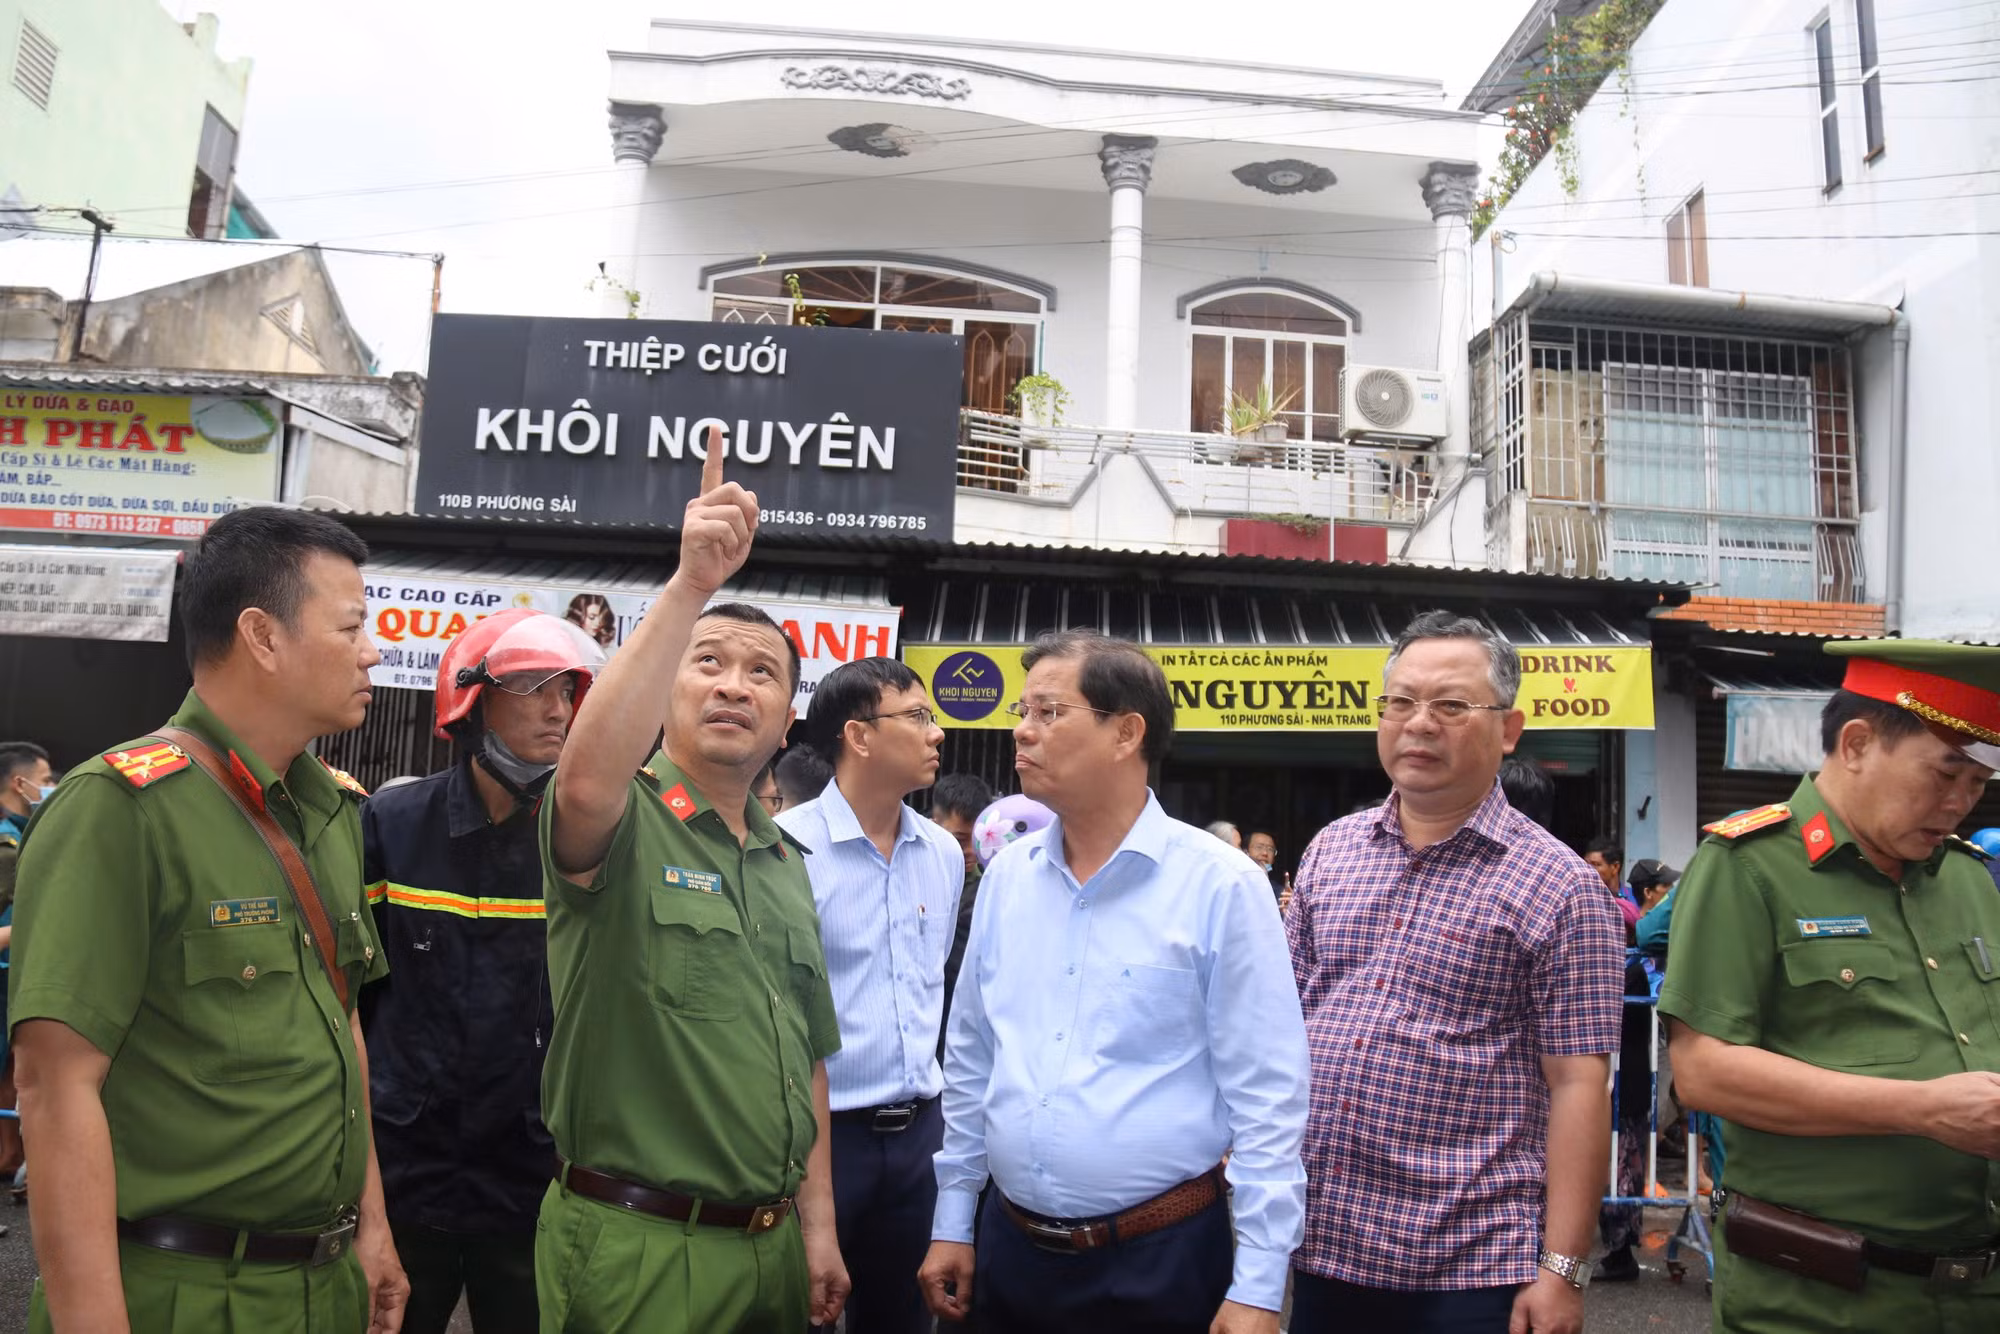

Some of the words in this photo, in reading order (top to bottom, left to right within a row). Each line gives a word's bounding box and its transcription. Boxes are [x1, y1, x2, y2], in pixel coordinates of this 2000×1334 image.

[584, 336, 685, 375] THIỆP
[698, 336, 787, 375] CƯỚI
[76, 398, 89, 411] &
[44, 413, 195, 454] PHÁT
[475, 398, 619, 456] KHÔI
[647, 412, 896, 470] NGUYÊN
[438, 494, 472, 508] 110B
[476, 495, 545, 511] PHƯƠNG
[758, 509, 814, 525] 815436
[827, 512, 866, 528] 0934
[869, 514, 897, 529] 796
[899, 516, 927, 530] 785
[400, 588, 446, 603] CAO
[454, 589, 502, 607] CẤP
[376, 608, 488, 642] QUA
[407, 652, 414, 669] &
[1161, 655, 1176, 666] IN
[1179, 650, 1207, 666] TẤT
[1232, 652, 1261, 666] CÁC
[1521, 655, 1616, 673] DRINK
[939, 687, 960, 698] KHOI
[962, 687, 998, 698] NGUYEN
[1170, 669, 1370, 710] NGUYÊN
[1533, 698, 1610, 717] FOOD
[1221, 714, 1237, 725] 110
[1239, 714, 1285, 726] PHƯƠNG
[1312, 714, 1334, 726] NHA
[1336, 714, 1371, 726] TRANG
